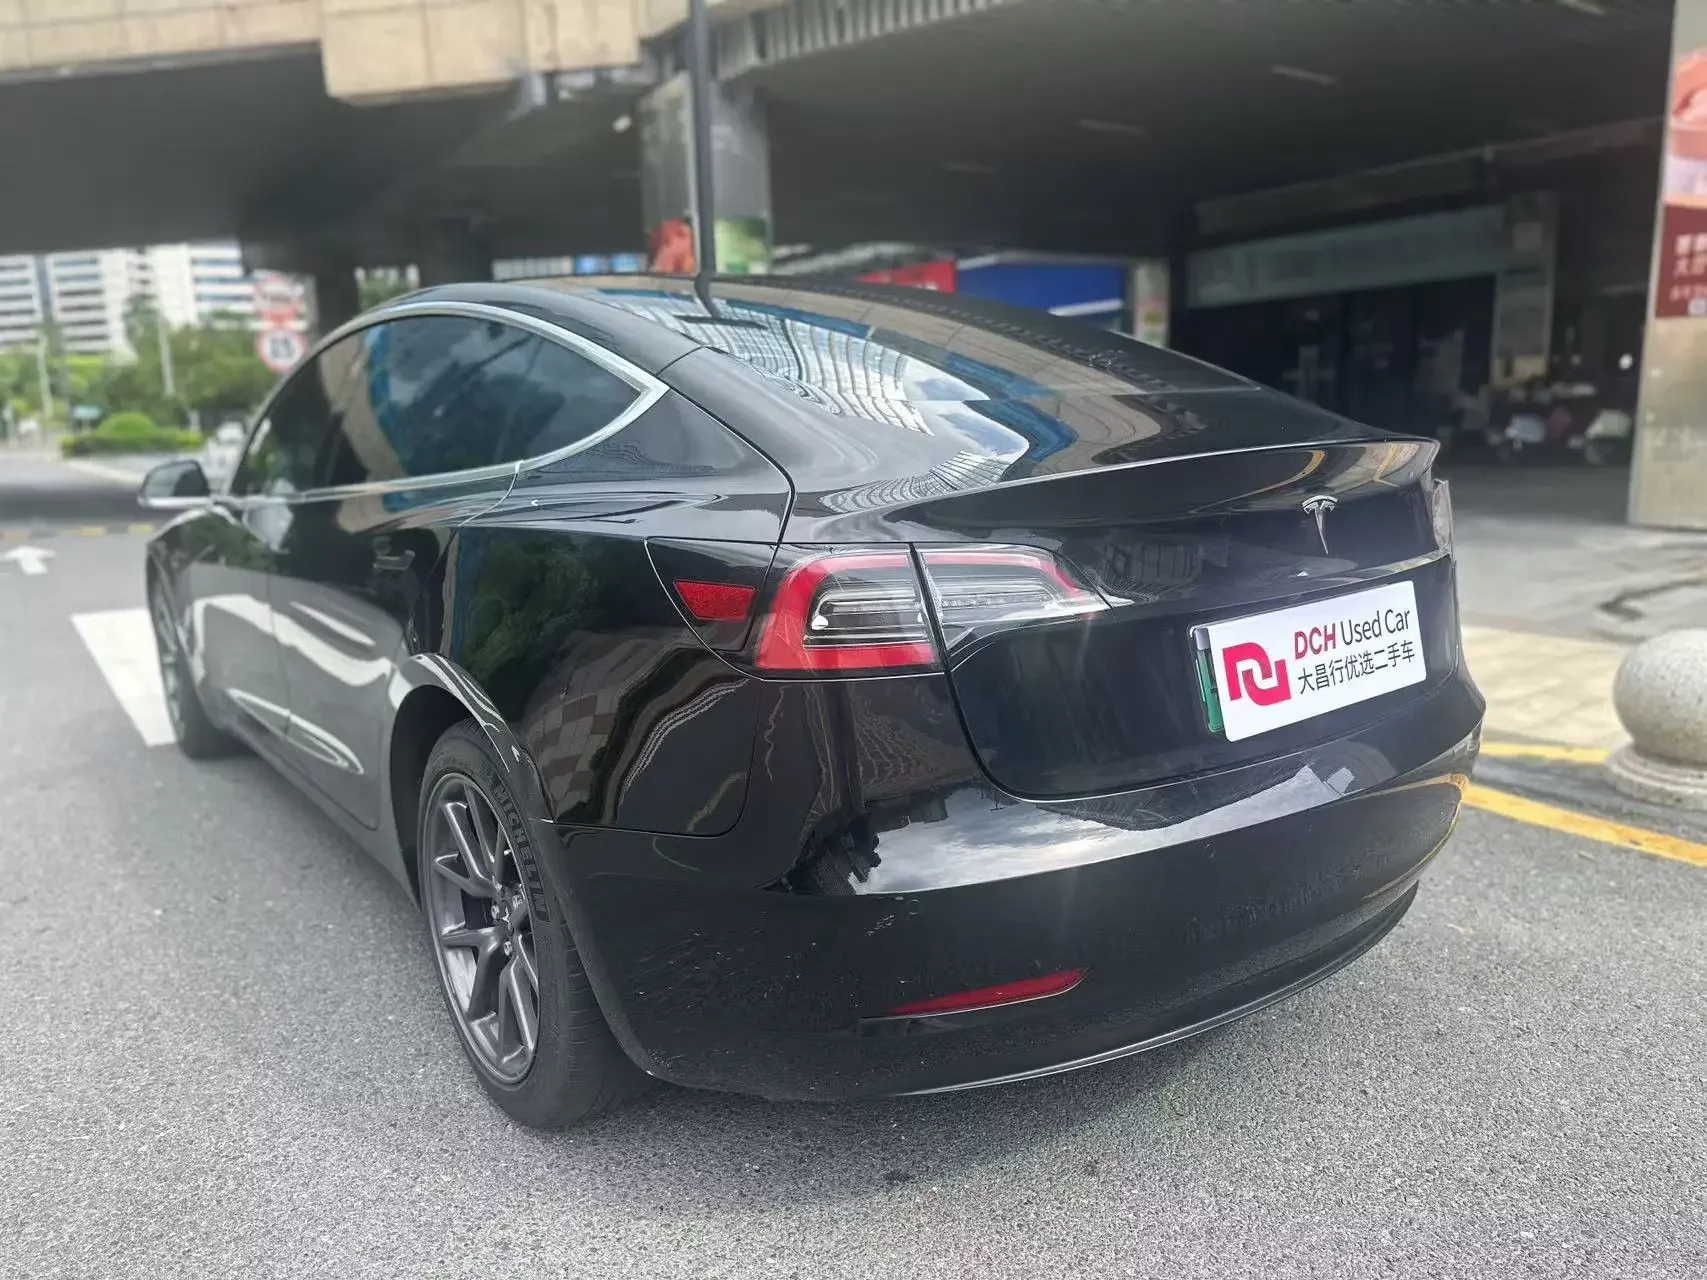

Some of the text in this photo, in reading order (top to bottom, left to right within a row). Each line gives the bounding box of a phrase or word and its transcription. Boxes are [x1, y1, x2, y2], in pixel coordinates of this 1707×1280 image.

[1294, 609, 1410, 660] DCH Used Car
[1297, 640, 1415, 694] 大昌行优选二手车
[494, 785, 547, 912] MICHELIN
